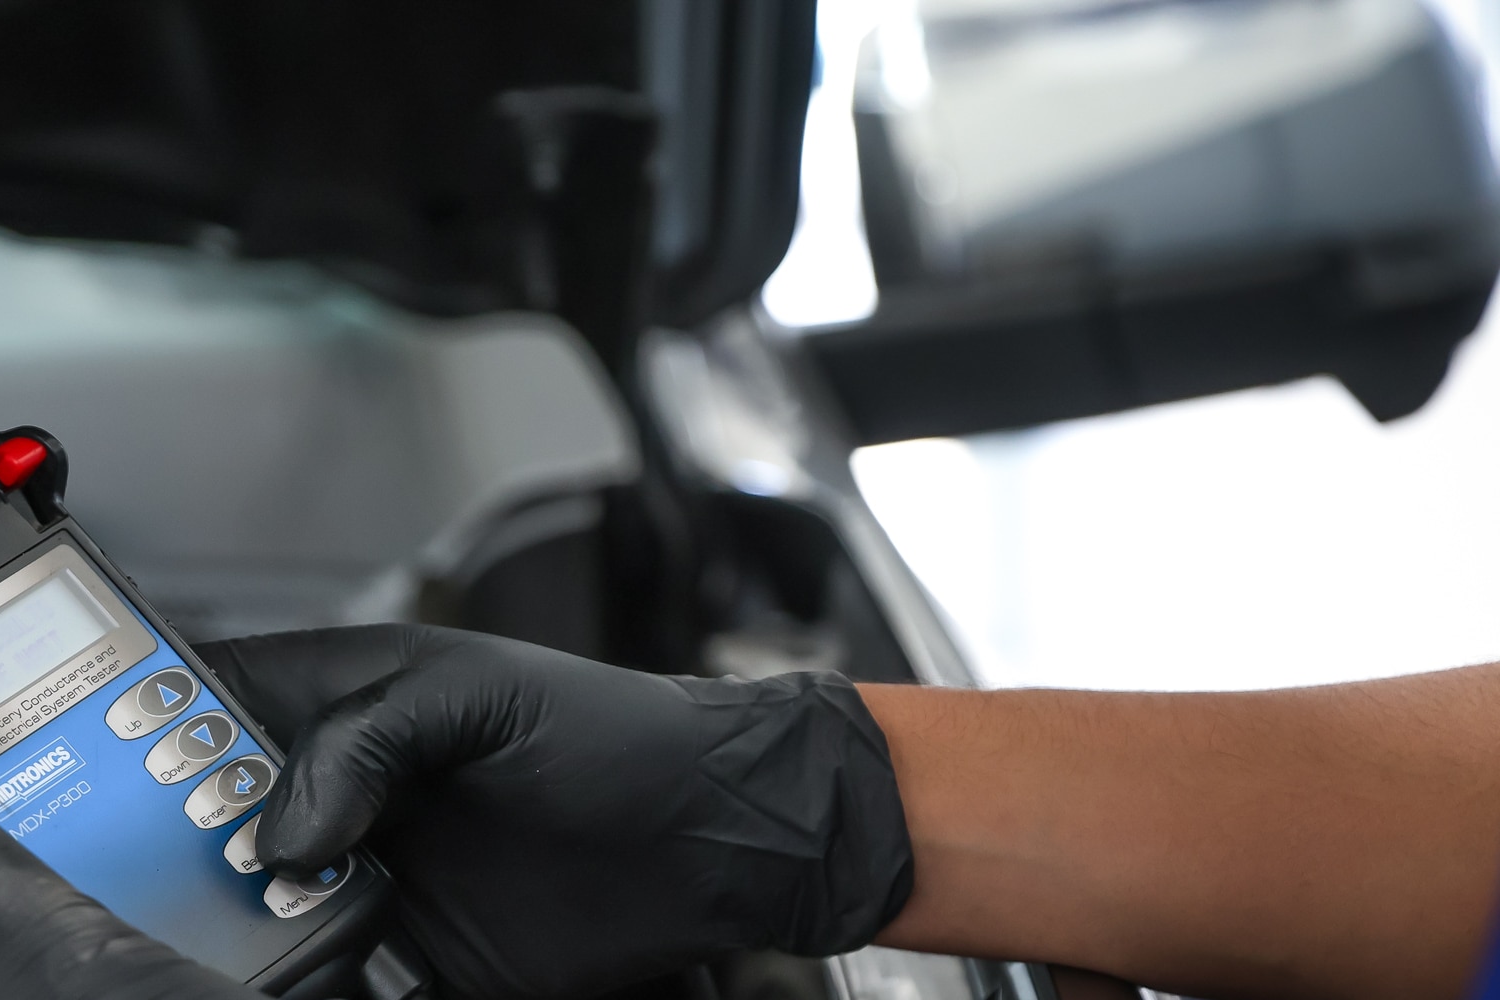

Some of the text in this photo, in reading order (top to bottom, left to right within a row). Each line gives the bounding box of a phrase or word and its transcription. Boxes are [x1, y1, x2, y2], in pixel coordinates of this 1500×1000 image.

[21, 661, 95, 711] Conductance
[94, 644, 117, 663] and
[40, 683, 86, 716] System
[82, 659, 121, 687] Tester
[125, 720, 142, 733] Up
[160, 760, 191, 782] Down
[8, 780, 92, 841] MDX-P300
[200, 804, 227, 827] Enter
[241, 856, 259, 871] Ba
[280, 894, 309, 915] Menu
